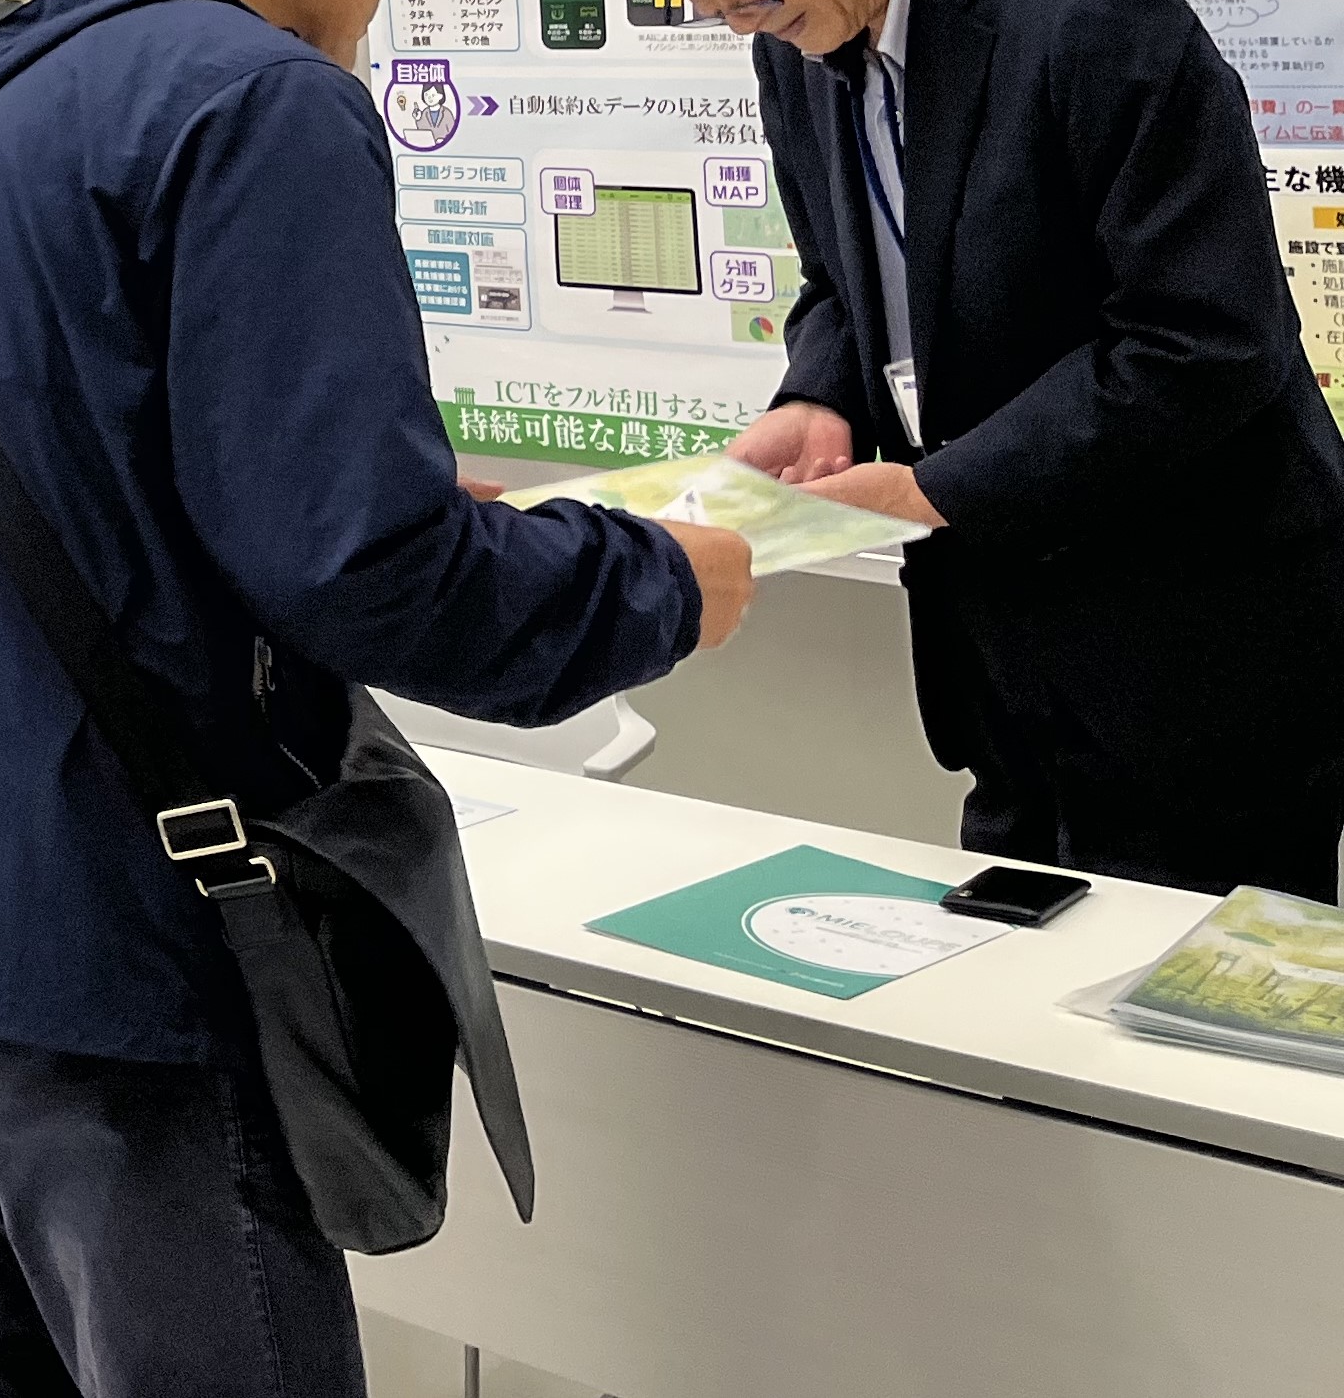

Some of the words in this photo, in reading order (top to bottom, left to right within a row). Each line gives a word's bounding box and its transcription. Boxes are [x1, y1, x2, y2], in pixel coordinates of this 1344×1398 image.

[462, 35, 490, 46] その他
[396, 63, 446, 83] 自治体
[694, 123, 766, 145] 業務負
[413, 164, 507, 182] 自動グラフ作成
[719, 165, 752, 183] 捕獲
[553, 175, 581, 192] 個体
[712, 185, 759, 201] MAP
[434, 199, 487, 217] 情報分析
[555, 194, 582, 212] 管理
[427, 228, 494, 247] 確認書対応
[726, 259, 757, 278] 分析
[720, 277, 765, 296] グラフ
